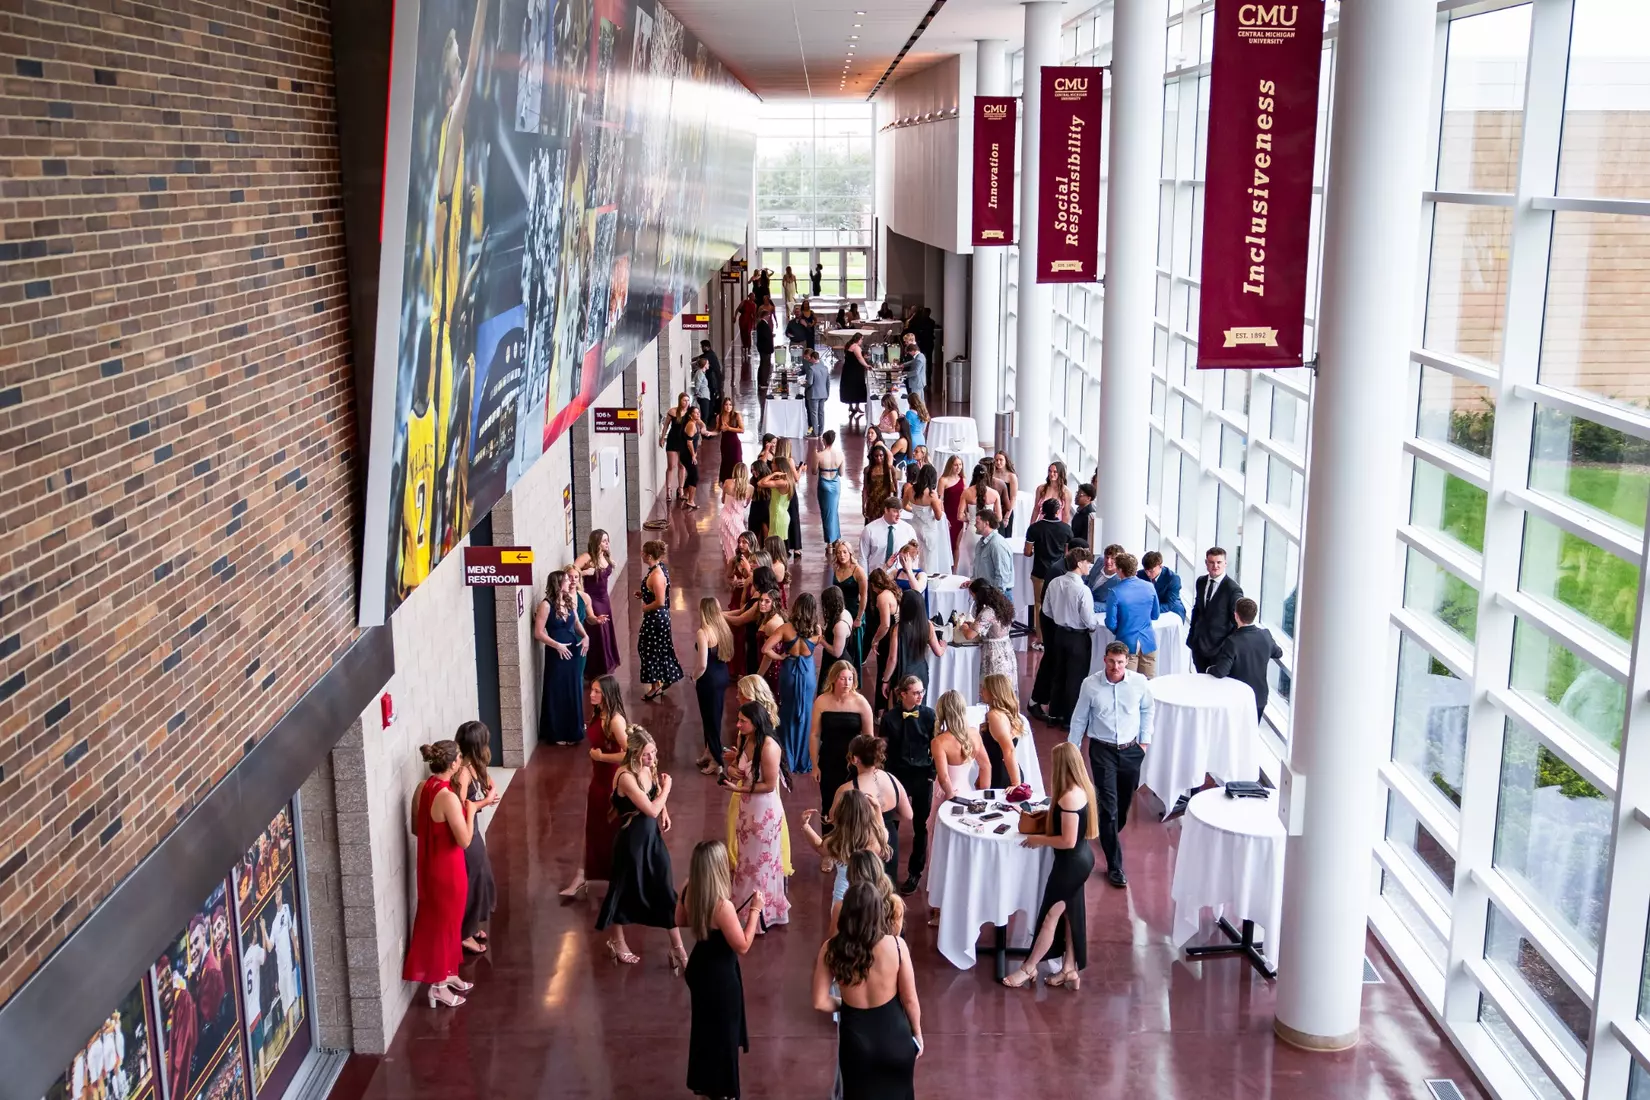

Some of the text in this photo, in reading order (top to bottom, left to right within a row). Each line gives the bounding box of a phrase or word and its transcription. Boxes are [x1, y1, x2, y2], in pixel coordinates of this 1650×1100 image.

[1238, 4, 1299, 26] CMU
[1054, 78, 1089, 91] CMU
[983, 104, 1007, 113] CMU
[988, 143, 999, 209] Innovation
[1065, 114, 1085, 247] Responsibility
[1243, 79, 1276, 297] Inclusiveness
[1054, 176, 1069, 232] Social
[467, 565, 496, 574] MEN'S
[467, 575, 520, 584] RESTROOM
[247, 968, 253, 995] 6
